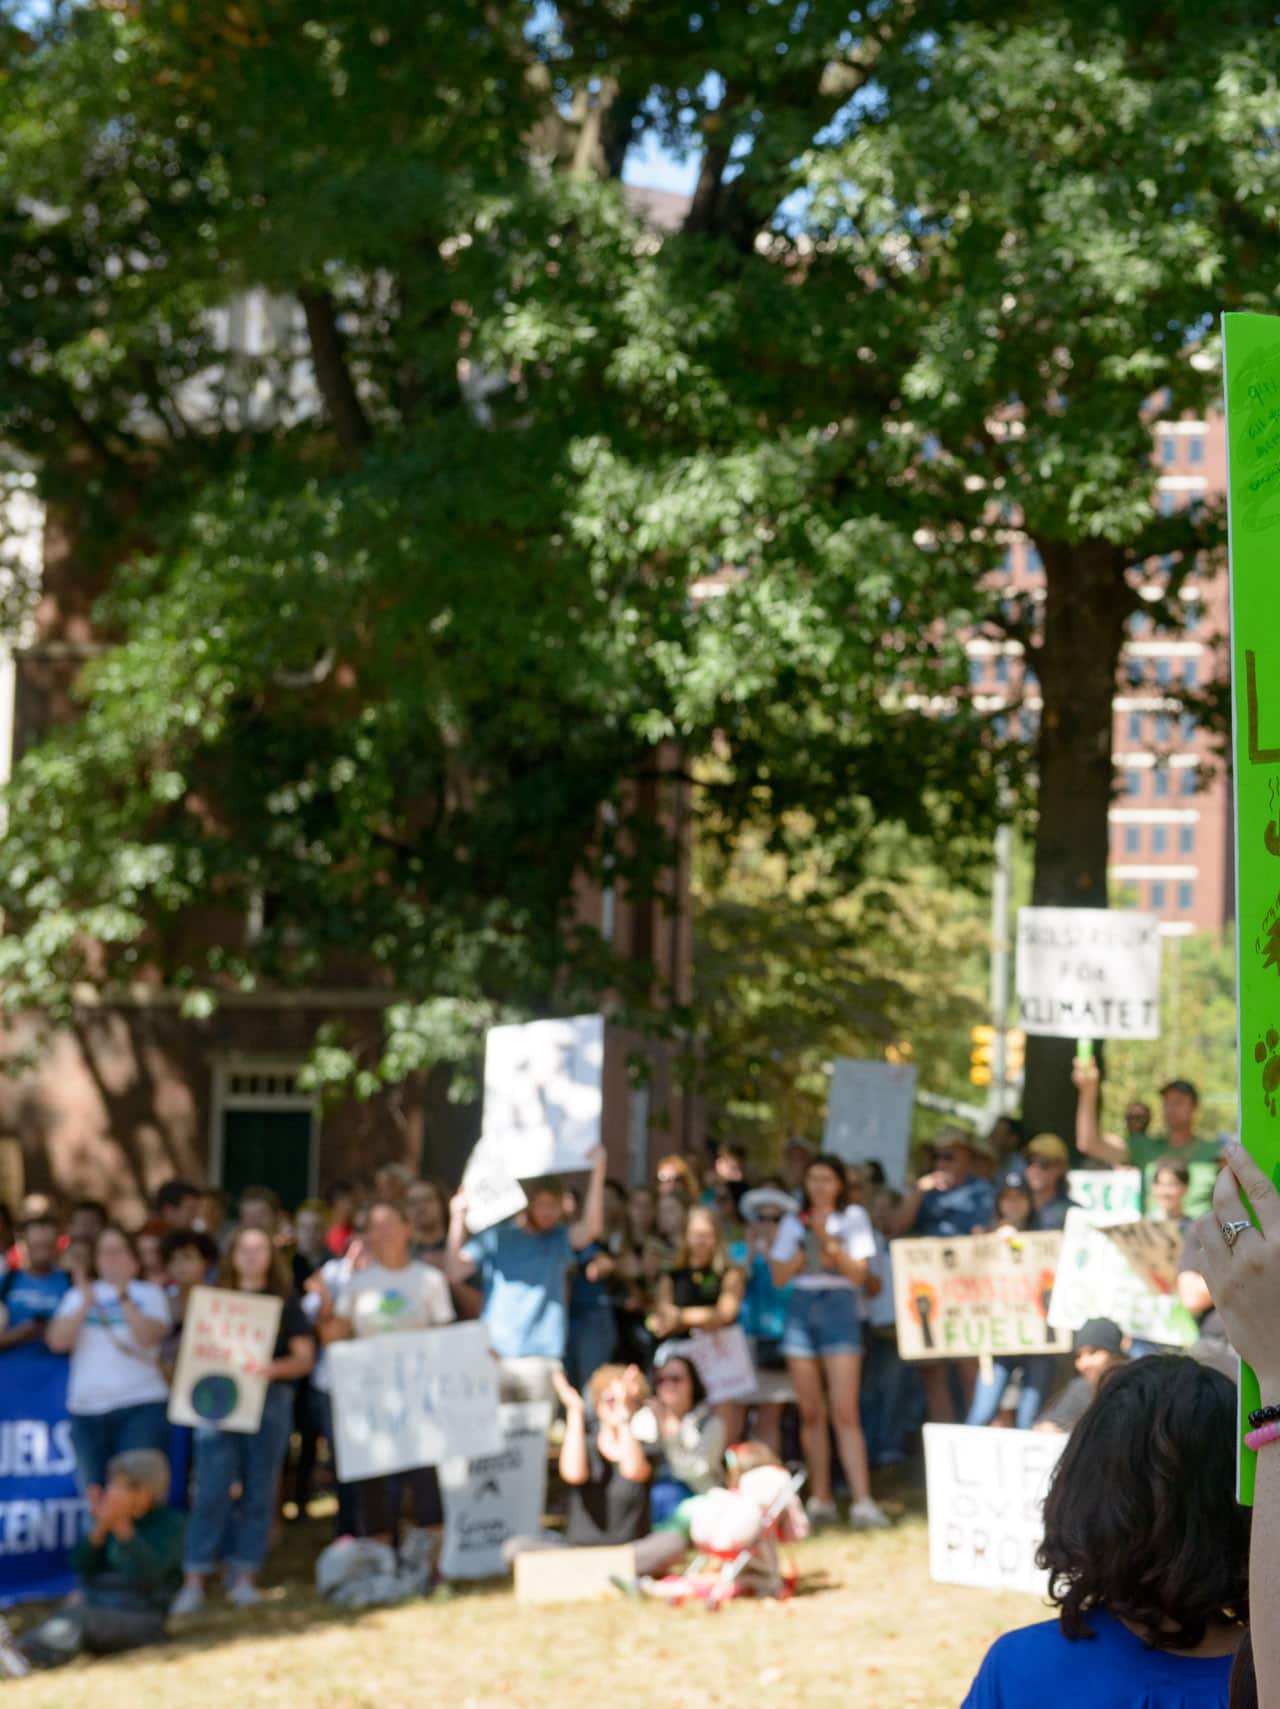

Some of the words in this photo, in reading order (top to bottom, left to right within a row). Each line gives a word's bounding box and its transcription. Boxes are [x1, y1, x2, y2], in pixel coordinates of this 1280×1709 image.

[944, 1316, 1035, 1349] FUEL
[947, 1440, 1048, 1488] LIF
[946, 1523, 1040, 1574] PRO
